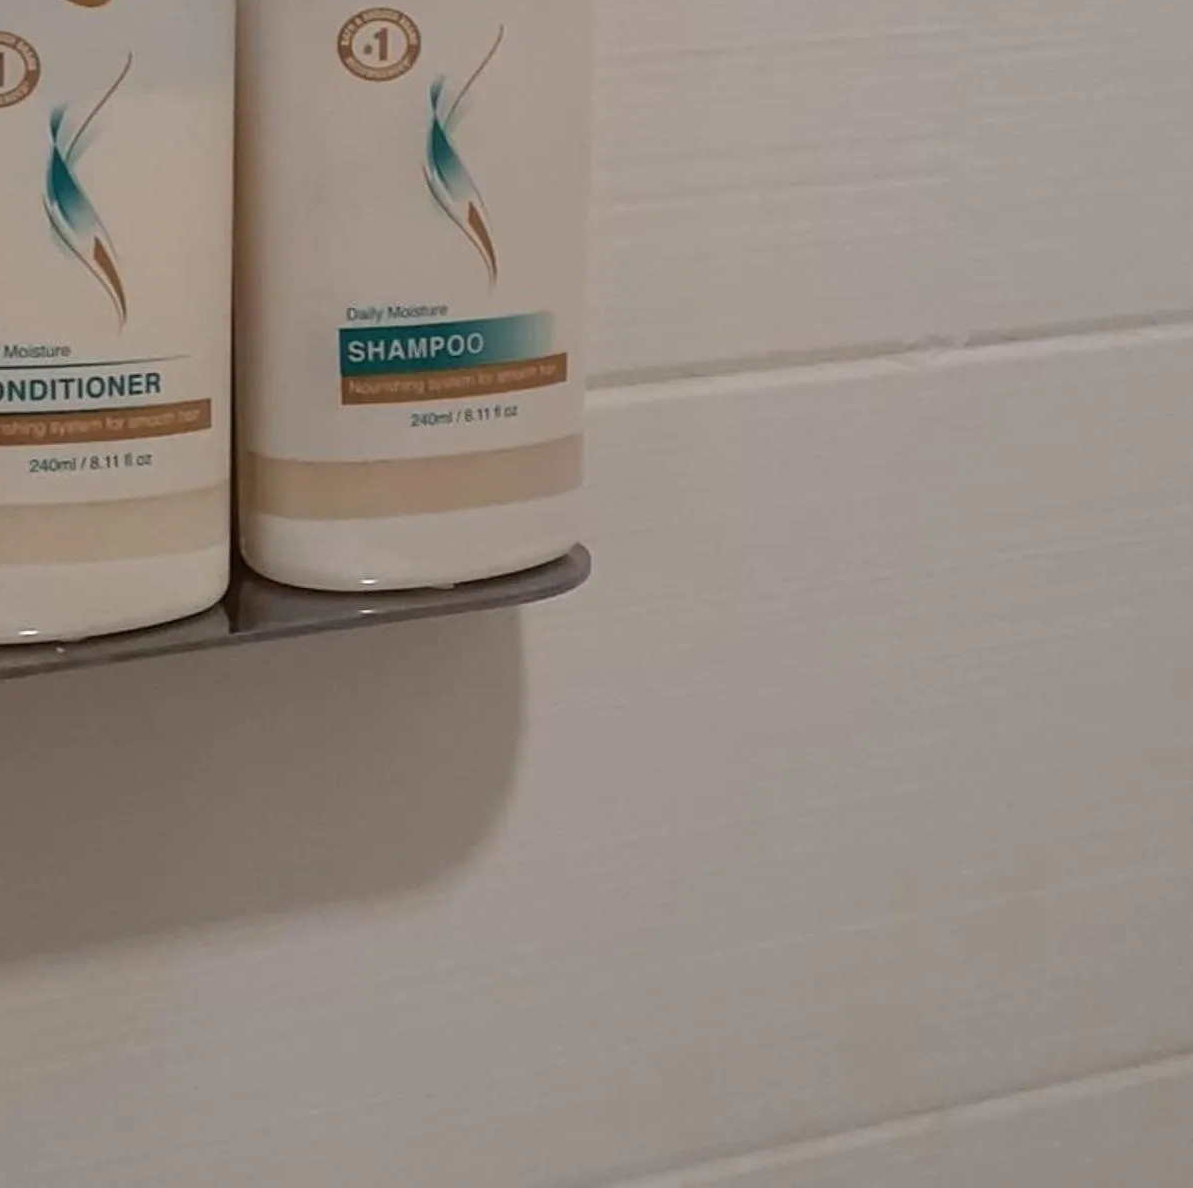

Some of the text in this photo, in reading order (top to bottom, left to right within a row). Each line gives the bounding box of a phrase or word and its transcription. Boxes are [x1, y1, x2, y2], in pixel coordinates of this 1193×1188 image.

[346, 303, 448, 324] Daily Moisture
[4, 343, 72, 359] Moisture
[347, 331, 484, 363] SHAMPOO
[49, 418, 103, 436] system
[410, 412, 453, 428] 240ml
[29, 457, 77, 473] 240ml
[89, 454, 119, 471] 8.11
[136, 453, 152, 467] oz
